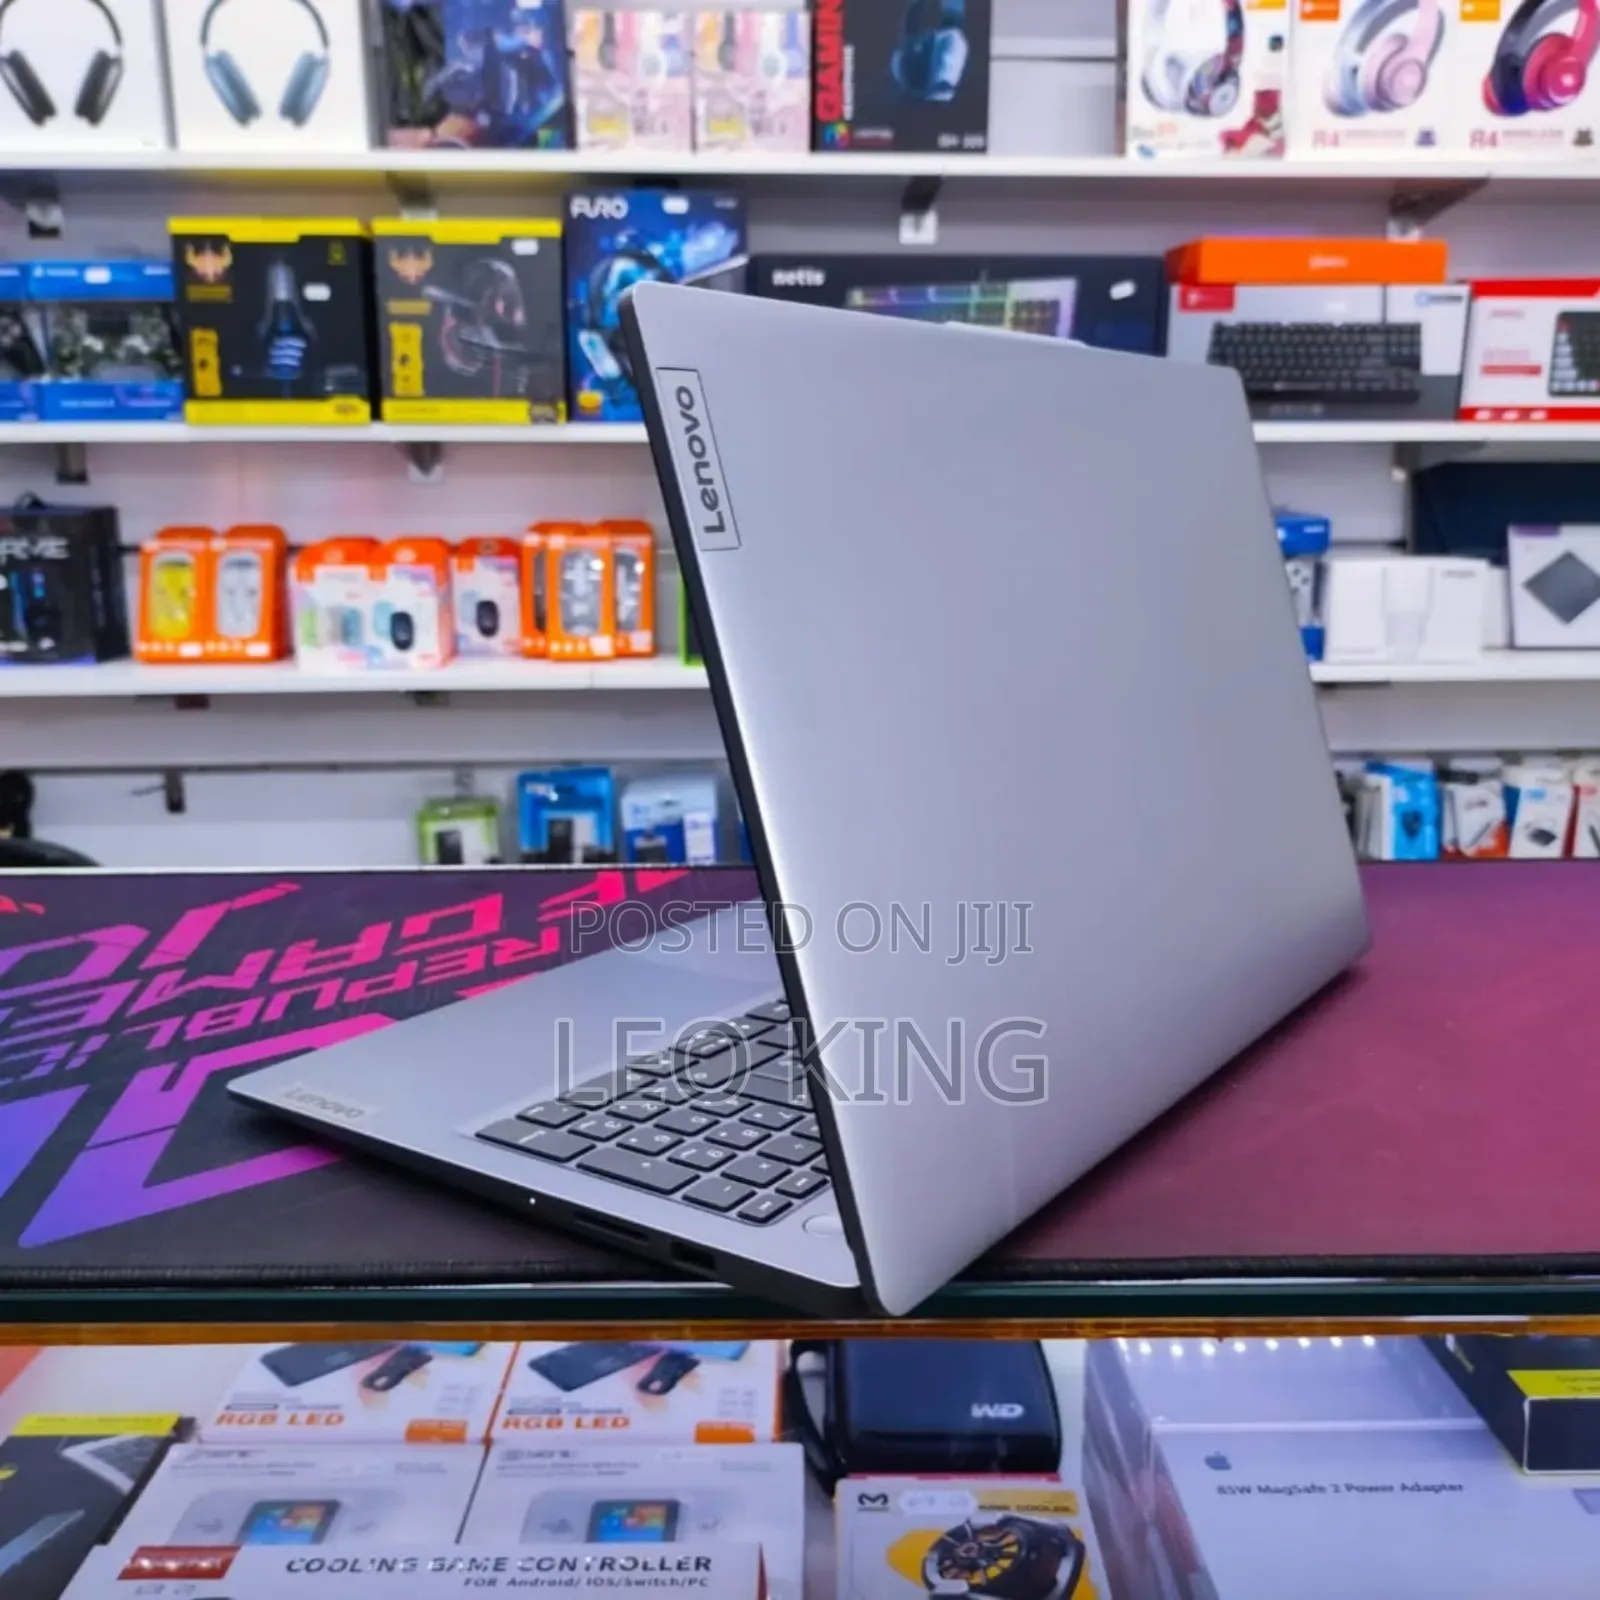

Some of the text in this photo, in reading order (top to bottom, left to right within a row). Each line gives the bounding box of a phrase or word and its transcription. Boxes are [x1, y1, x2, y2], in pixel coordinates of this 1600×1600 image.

[675, 385, 727, 534] Lenovo
[284, 1086, 366, 1119] Lenovo
[215, 1411, 345, 1426] RGB LED
[971, 1402, 1024, 1419] WD
[502, 1416, 630, 1430] RGB LED
[1257, 1483, 1326, 1496] MagSafe
[1331, 1484, 1341, 1493] 2
[1344, 1482, 1394, 1493] Power
[1400, 1482, 1464, 1495] Adapter
[286, 1555, 713, 1574] COOLING GAME CONTROLLER
[463, 1577, 498, 1587] FOR
